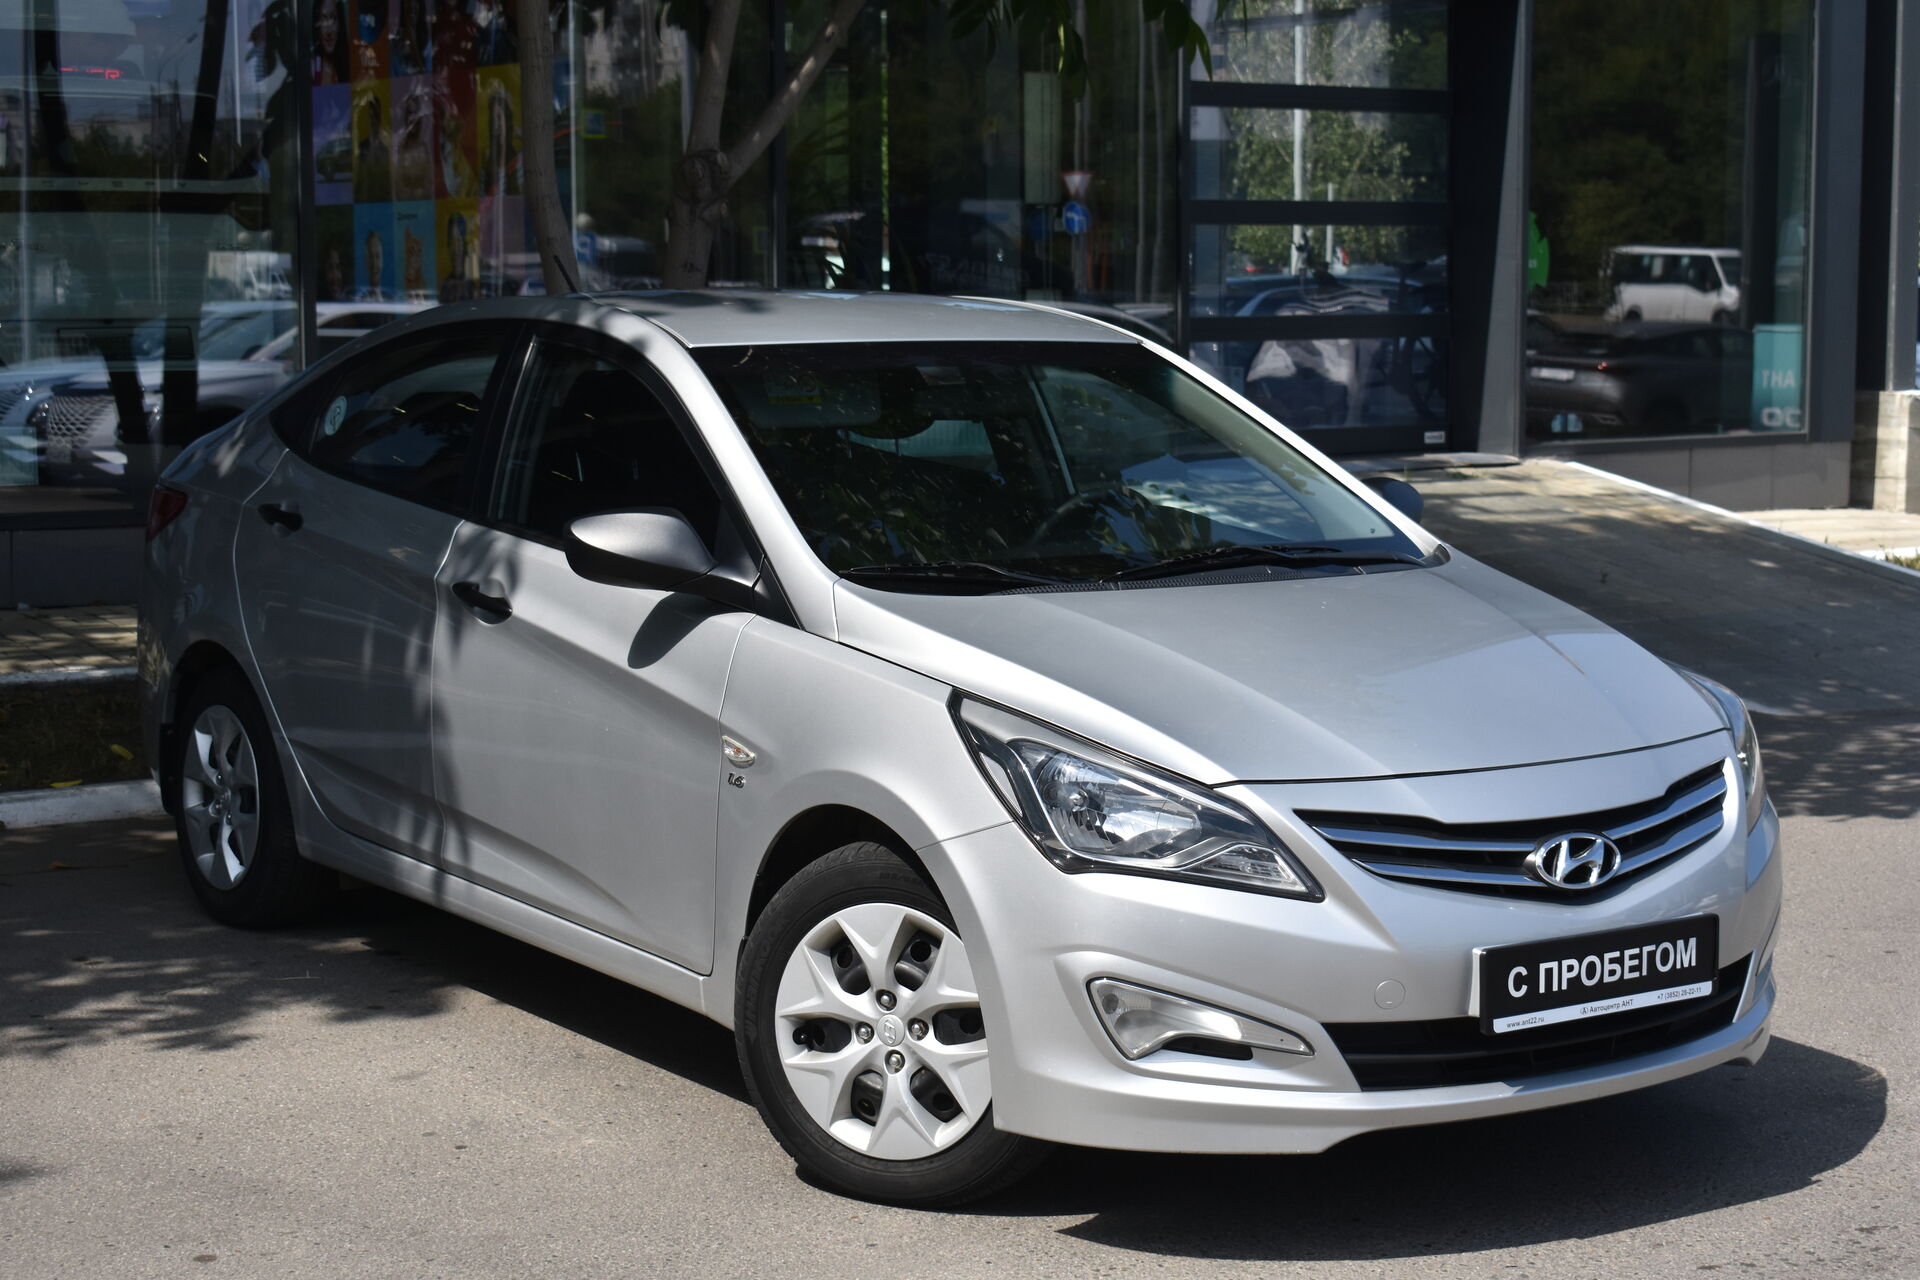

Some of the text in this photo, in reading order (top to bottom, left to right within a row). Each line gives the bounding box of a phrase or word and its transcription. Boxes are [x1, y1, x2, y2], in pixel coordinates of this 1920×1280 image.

[1507, 937, 1697, 998] С ПРОБЕГОМ
[1589, 1002, 1621, 1014] Автоцентр
